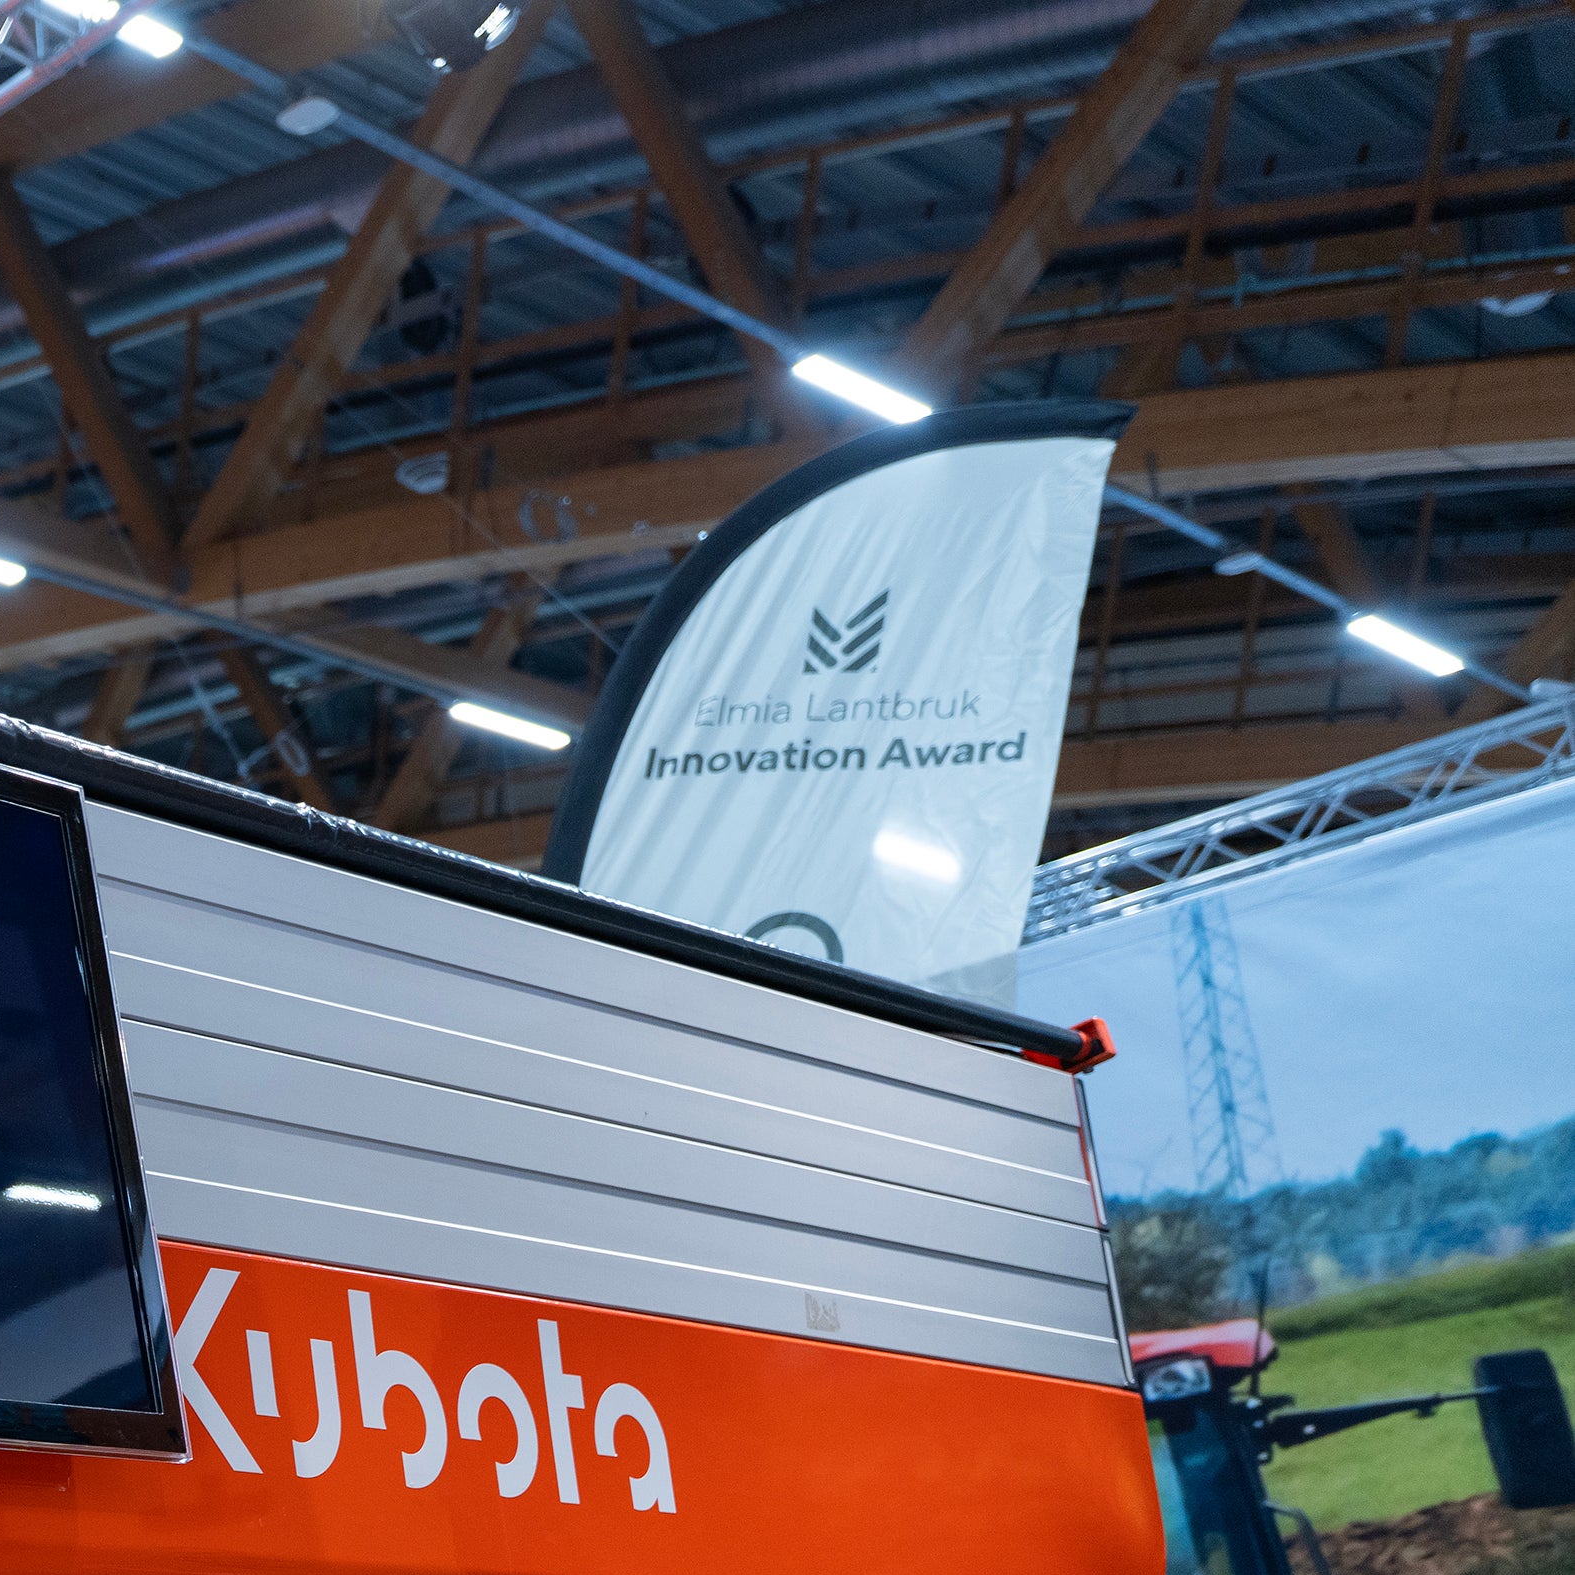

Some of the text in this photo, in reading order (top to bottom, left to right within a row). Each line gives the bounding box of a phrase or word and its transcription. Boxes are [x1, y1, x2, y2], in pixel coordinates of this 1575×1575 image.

[694, 688, 981, 728] Elmia Lantbruk
[643, 731, 1027, 781] Innovation Award
[173, 1266, 677, 1514] Kubota
